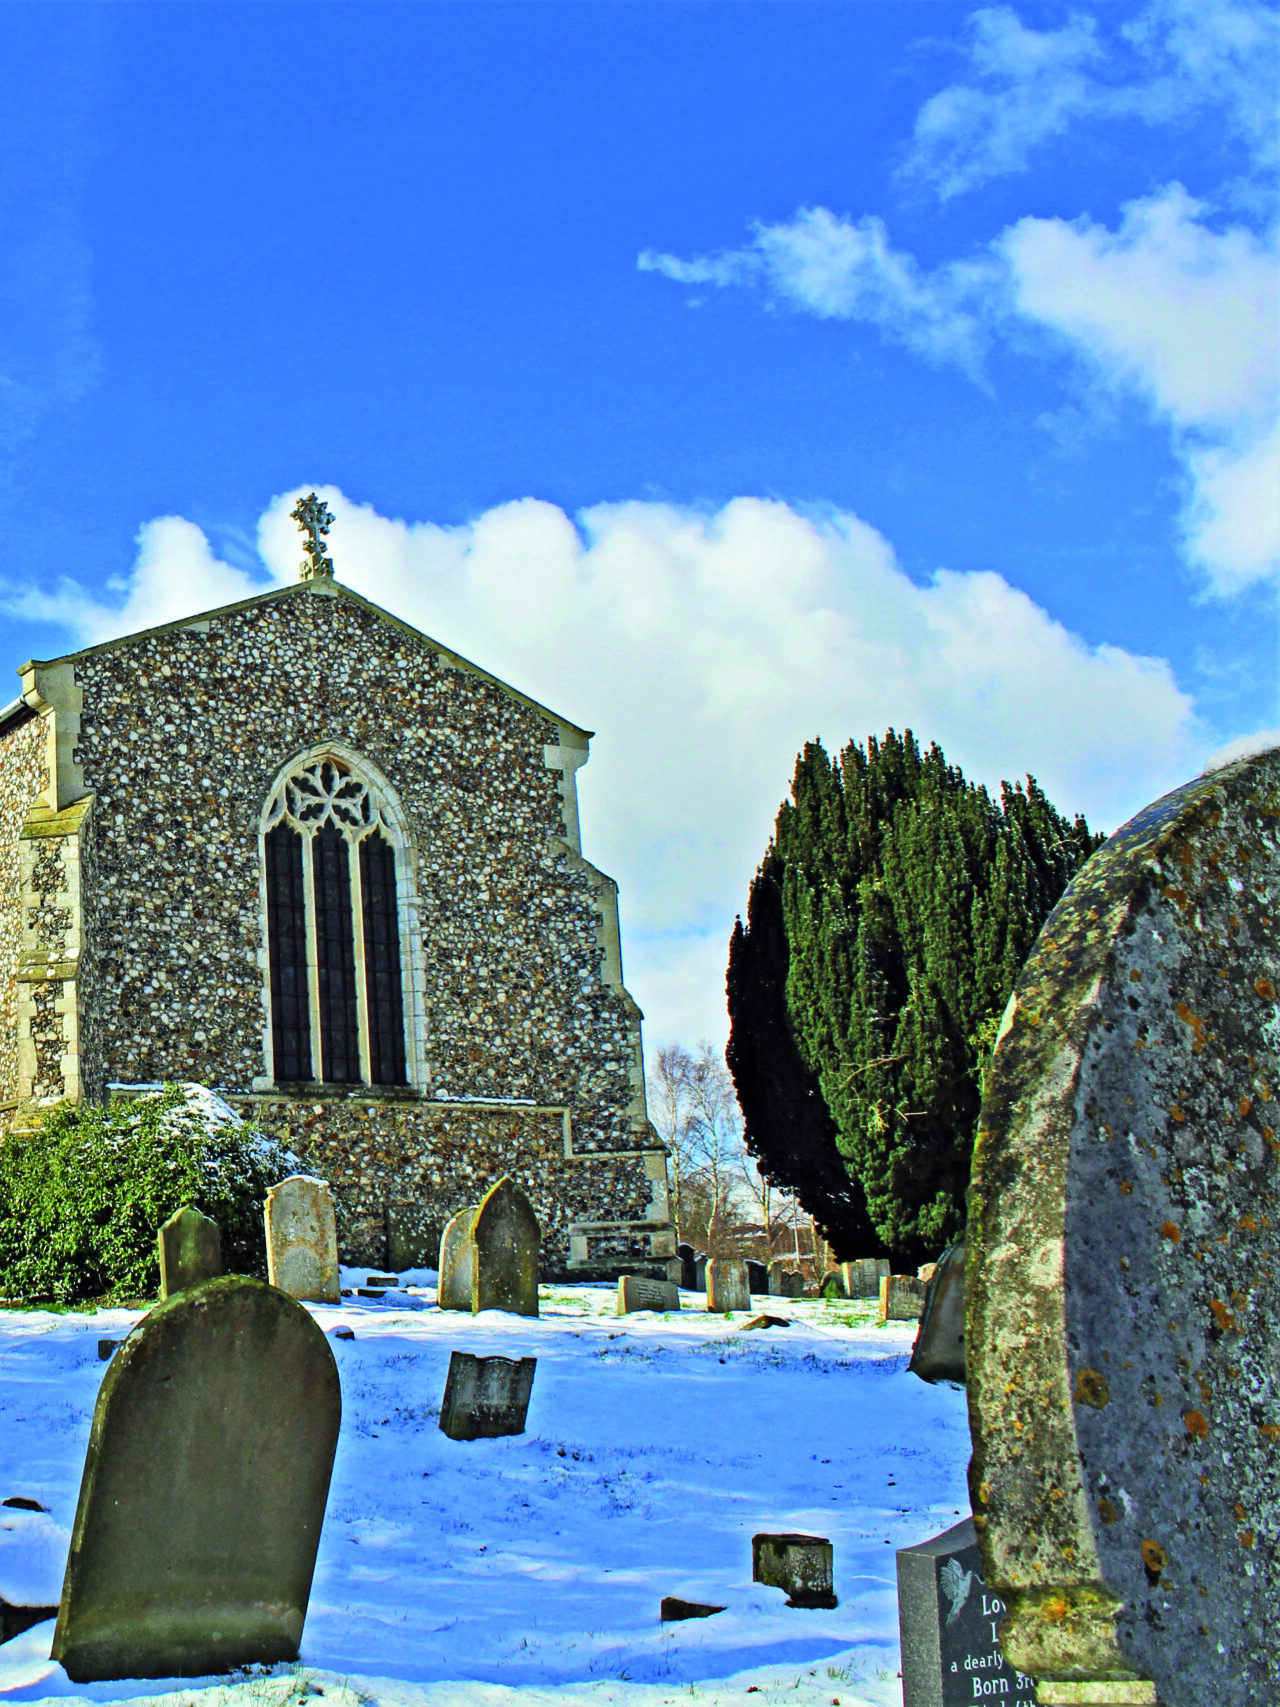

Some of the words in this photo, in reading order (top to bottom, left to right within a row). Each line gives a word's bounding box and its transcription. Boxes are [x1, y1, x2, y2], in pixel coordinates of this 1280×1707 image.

[950, 1661, 959, 1673] a
[964, 1650, 1004, 1670] dearly
[971, 1676, 1010, 1698] Born
